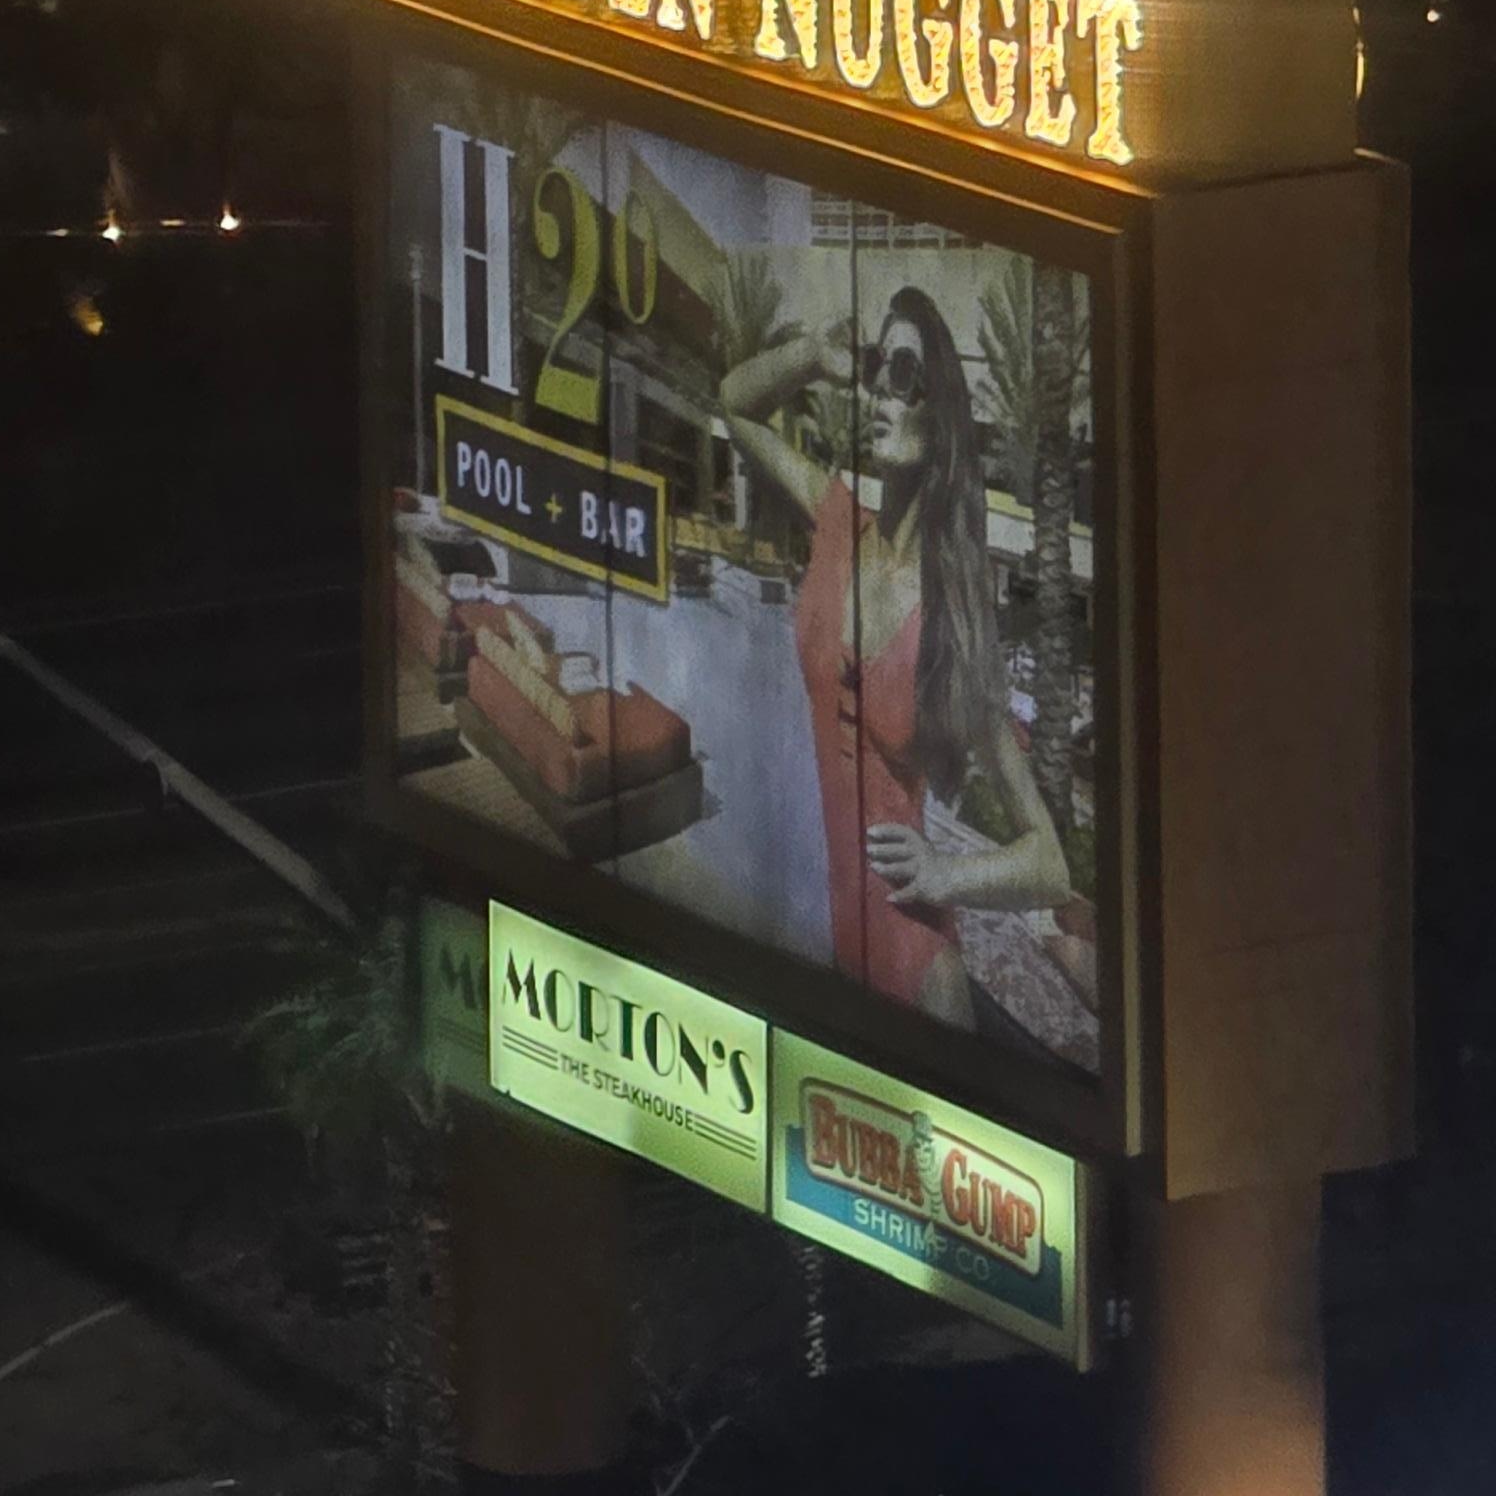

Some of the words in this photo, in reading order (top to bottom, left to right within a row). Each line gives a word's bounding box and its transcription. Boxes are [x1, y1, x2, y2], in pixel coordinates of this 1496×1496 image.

[456, 441, 532, 516] POOL
[579, 490, 647, 558] BAR
[501, 947, 755, 1116] MORTON'S
[559, 1053, 591, 1085] THE
[592, 1070, 694, 1133] STEAKHOUSE
[808, 1093, 924, 1208] BUBBA
[941, 1148, 1037, 1260] GUMP
